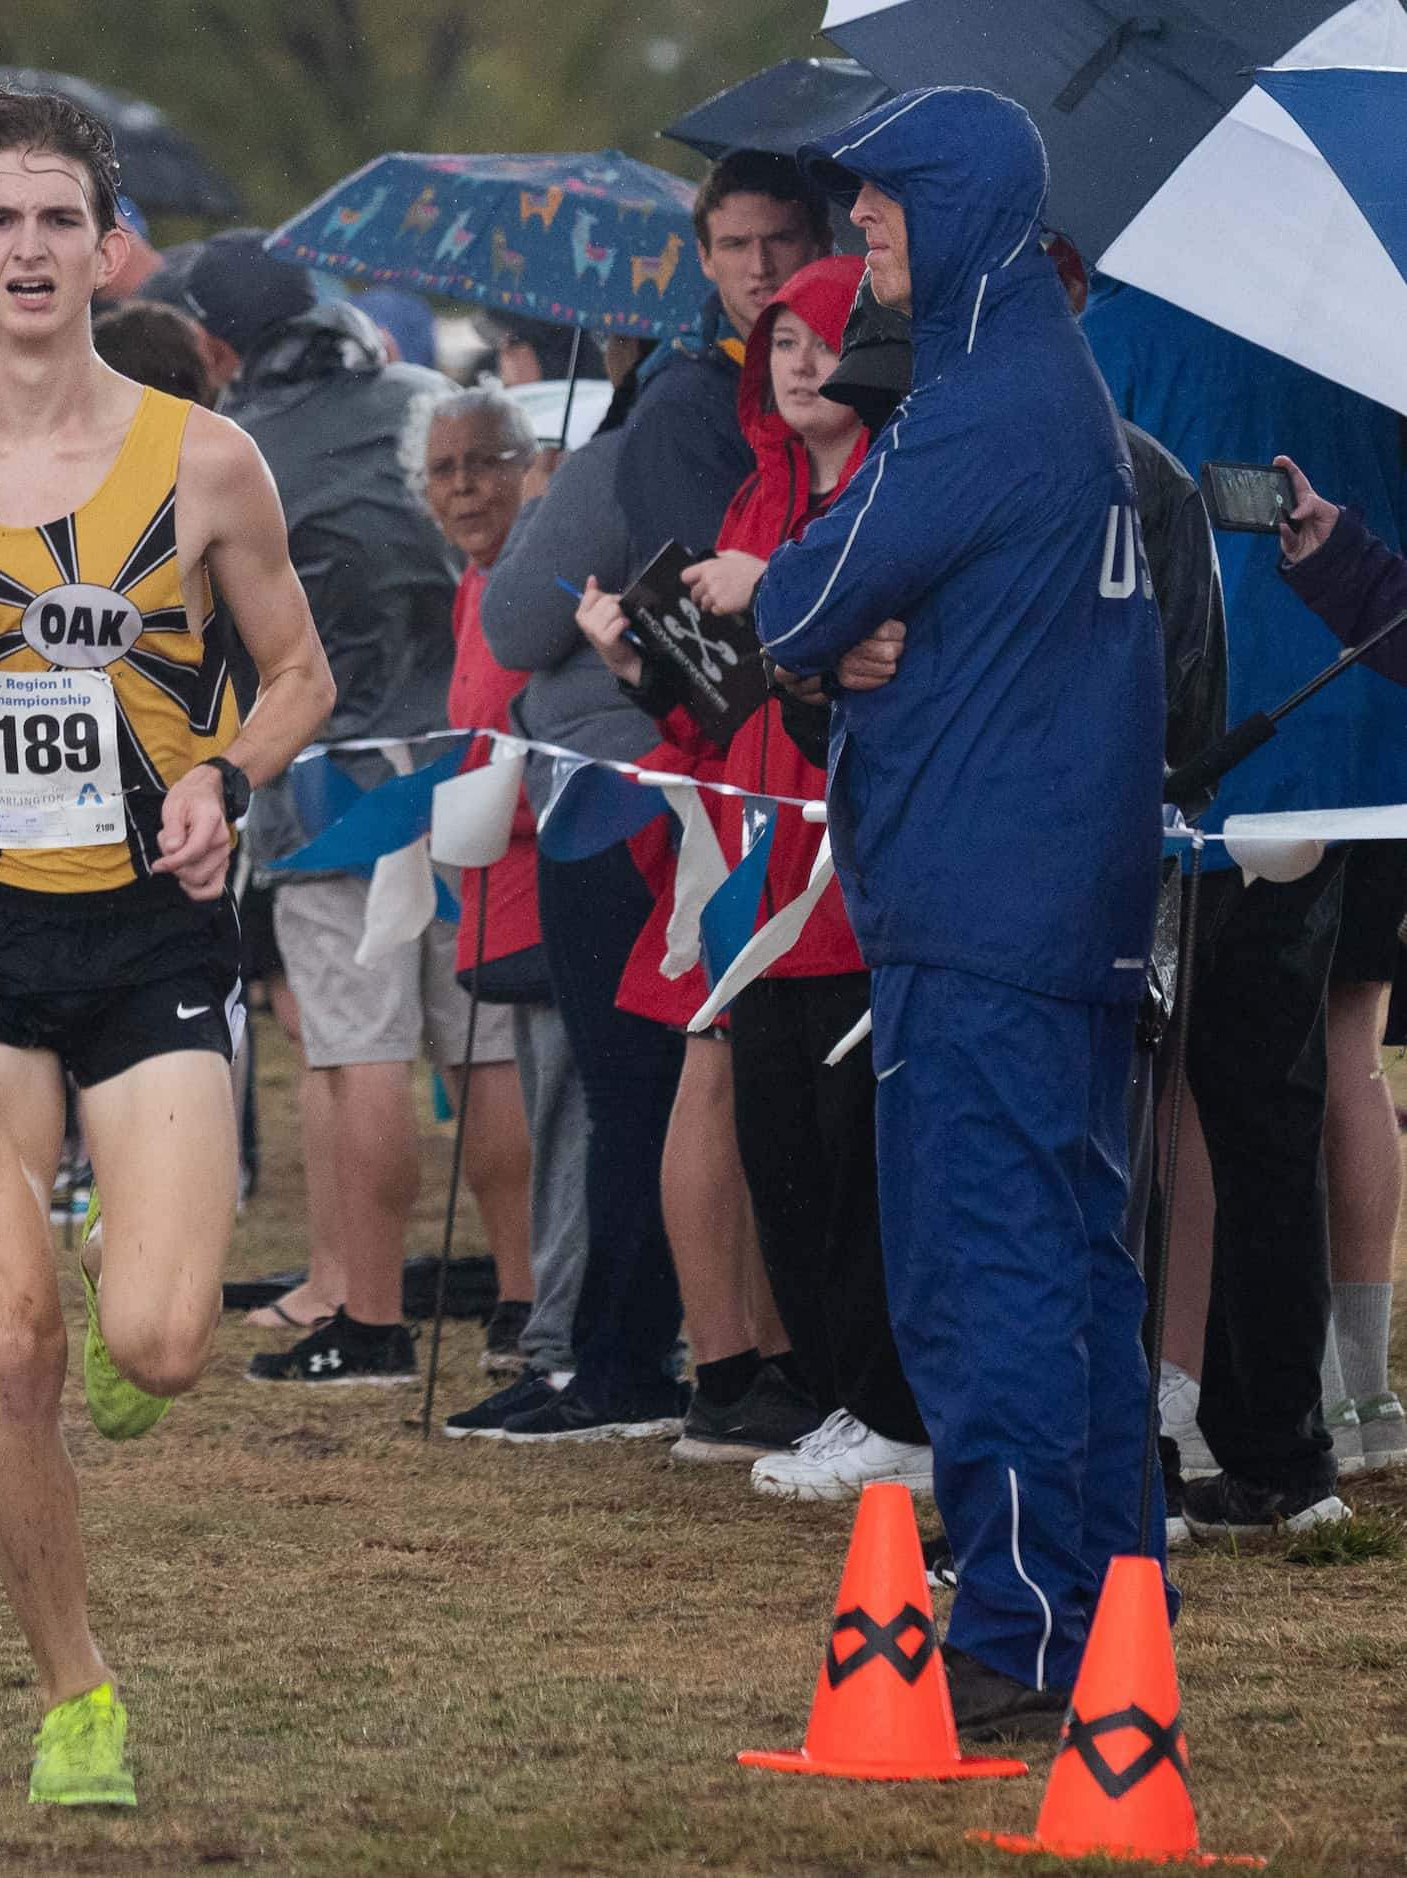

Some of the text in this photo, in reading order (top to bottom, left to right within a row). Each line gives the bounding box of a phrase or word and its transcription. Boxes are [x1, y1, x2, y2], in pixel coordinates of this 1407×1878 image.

[1098, 505, 1152, 600] U
[40, 603, 129, 647] OAK
[6, 678, 58, 692] Region
[62, 677, 72, 689] II
